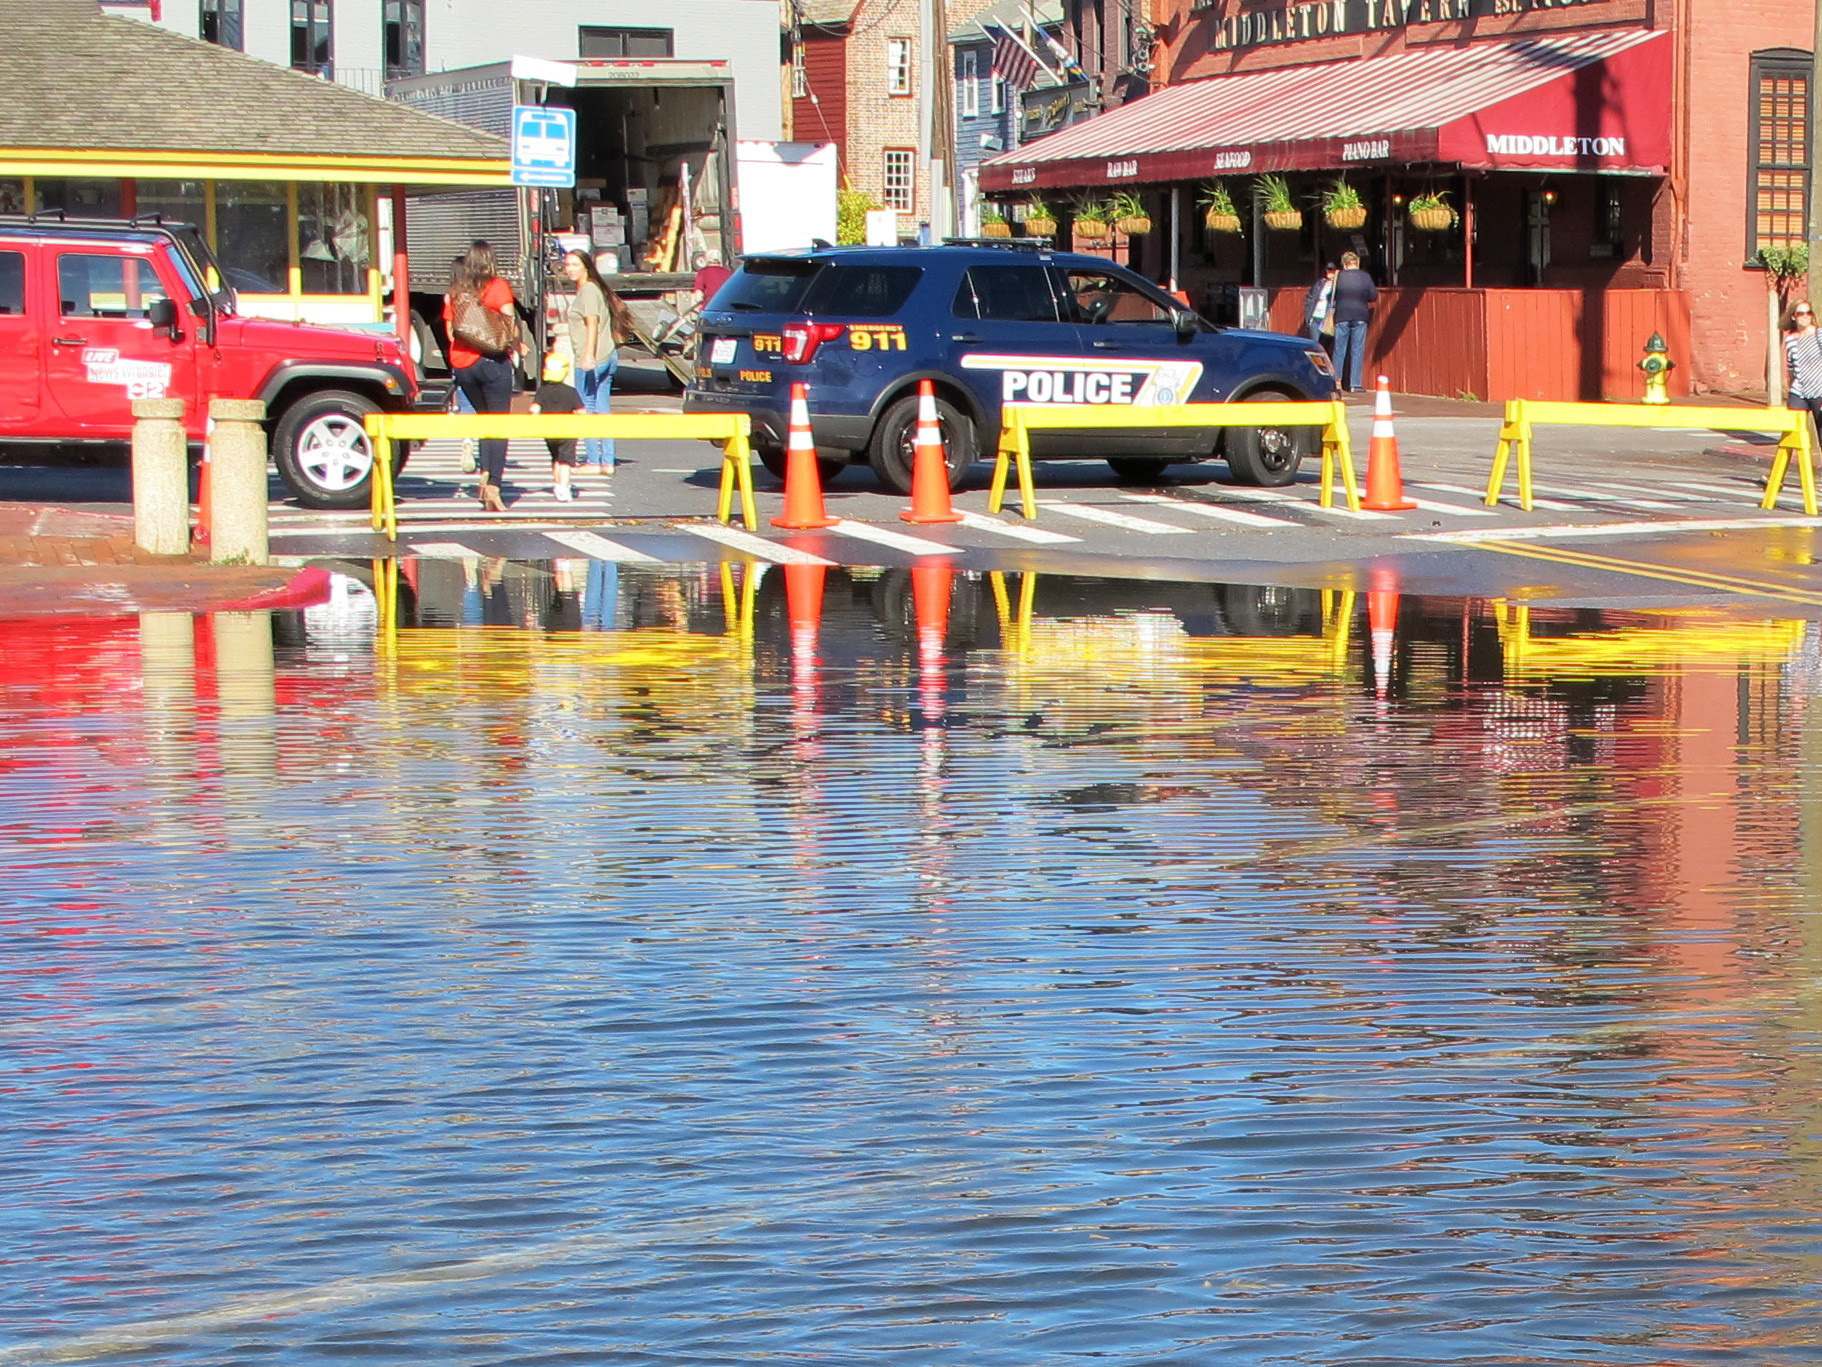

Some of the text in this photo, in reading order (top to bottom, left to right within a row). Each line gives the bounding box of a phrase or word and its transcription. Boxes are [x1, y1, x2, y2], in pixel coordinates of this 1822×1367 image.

[1214, 0, 1346, 49] MIDDLETON
[1365, 0, 1471, 29] TAVERN
[1371, 140, 1389, 158] BAR
[1486, 134, 1626, 156] MIDDLETON
[1122, 160, 1138, 177] BAR
[1213, 151, 1251, 170] SEAFOOD
[754, 339, 782, 352] 911
[850, 331, 908, 350] 911
[85, 351, 117, 363] LIVE
[740, 371, 772, 383] POLICE
[148, 382, 164, 399] 2
[1003, 370, 1133, 404] POLICE
